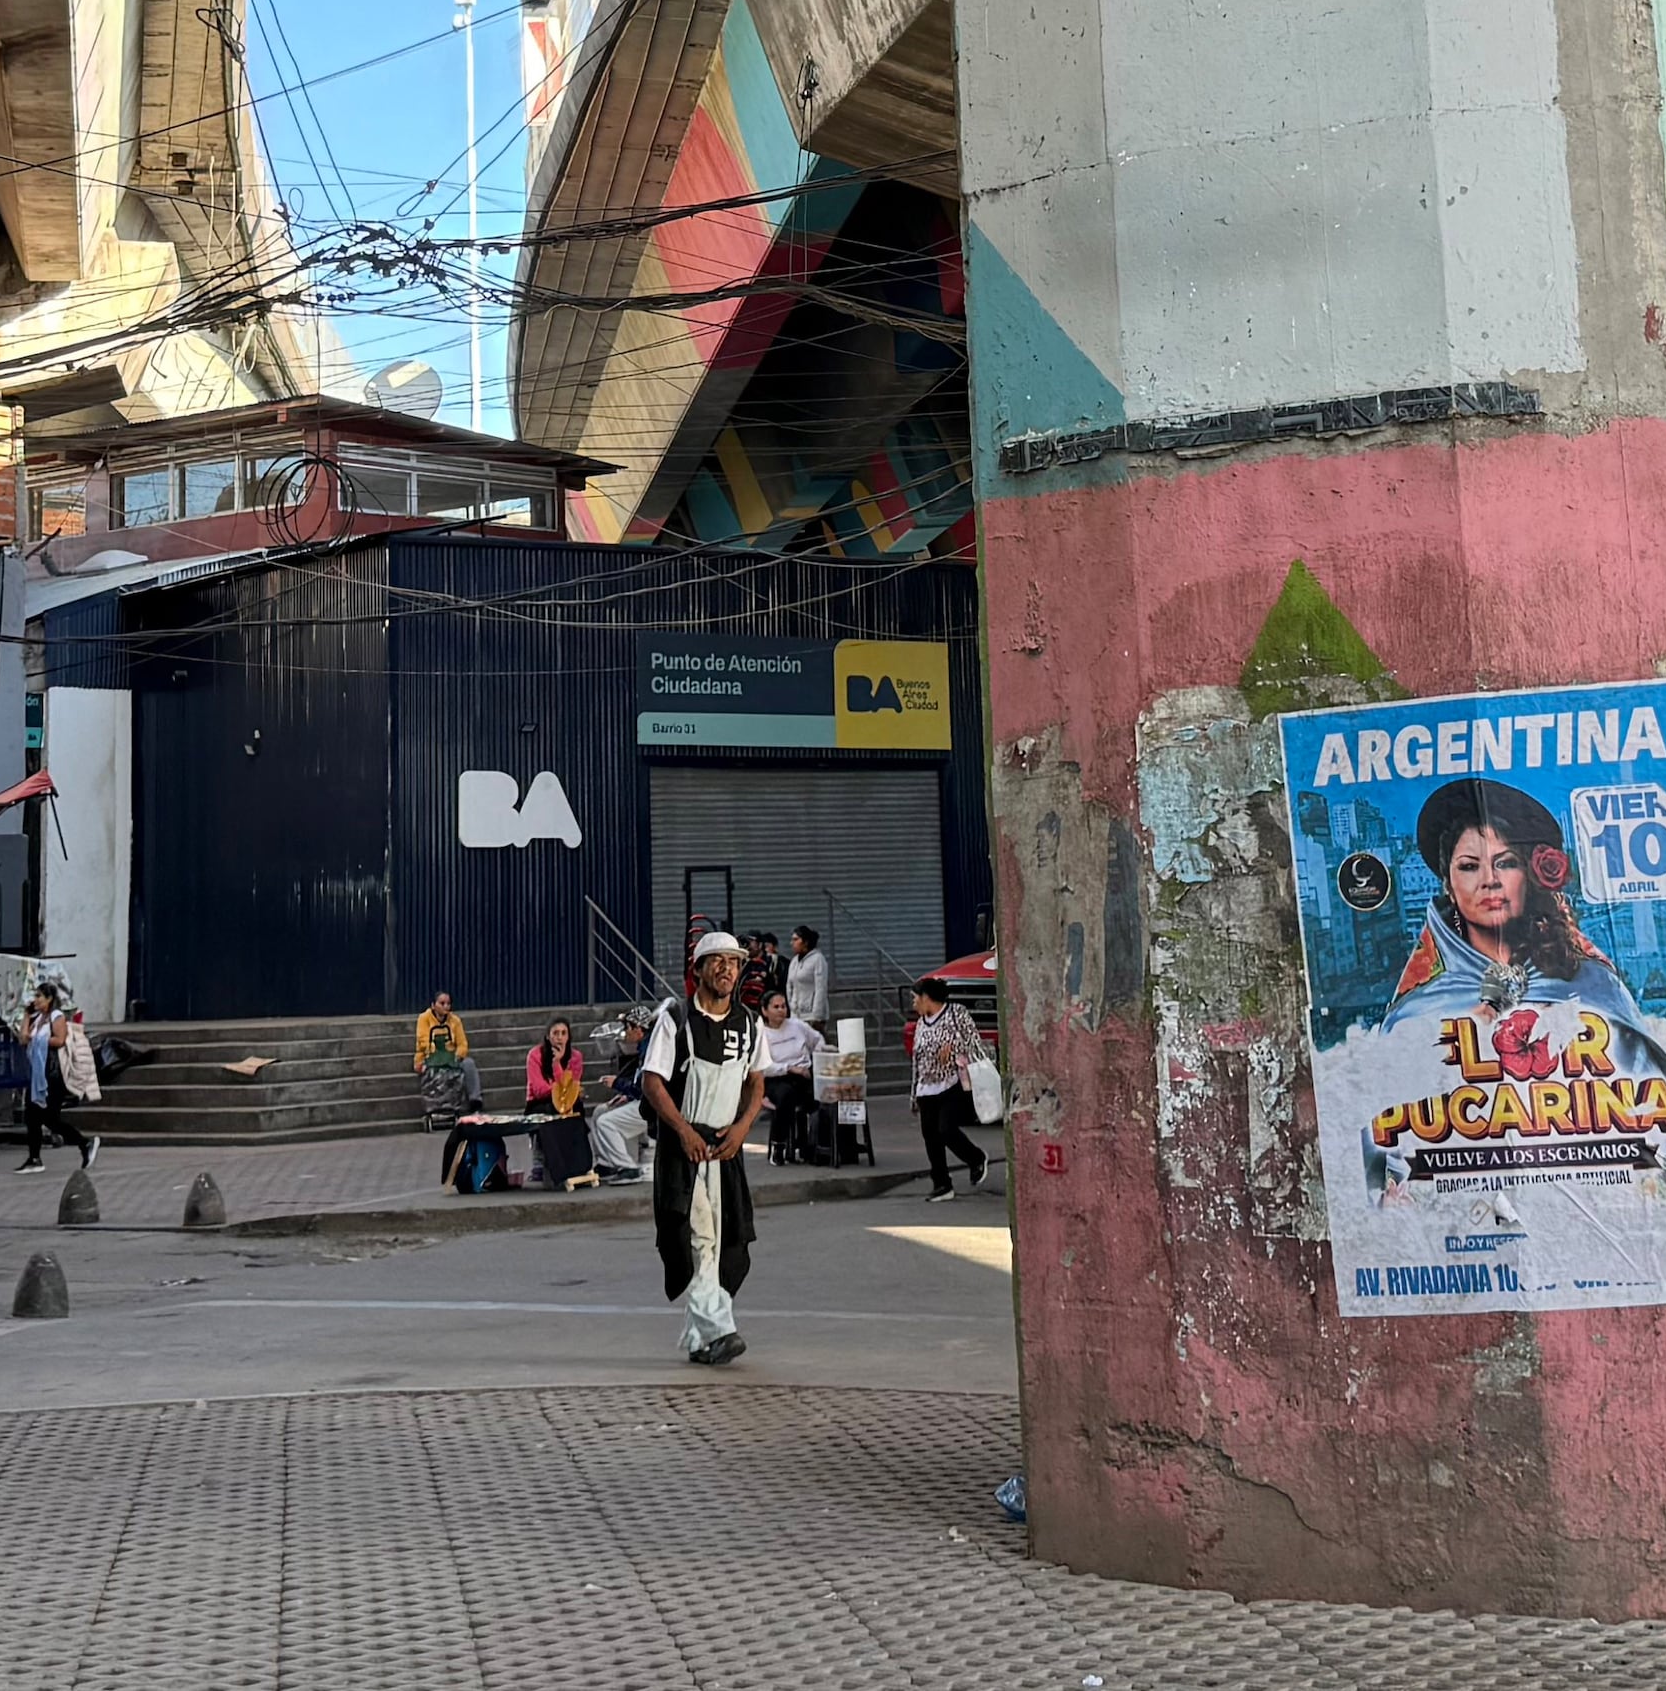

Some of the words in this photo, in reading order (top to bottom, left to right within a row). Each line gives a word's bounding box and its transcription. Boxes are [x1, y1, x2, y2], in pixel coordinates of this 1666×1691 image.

[650, 652, 702, 671] Punto
[704, 653, 726, 672] de
[728, 654, 802, 674] Atención
[650, 675, 743, 696] Ciudadana
[895, 678, 931, 690] Buenos
[846, 675, 903, 714] BA
[902, 689, 929, 700] Aires
[905, 699, 939, 711] Ciudad
[651, 722, 683, 734] Barrio
[458, 769, 583, 849] BA
[1618, 880, 1660, 895] ABRIL
[1422, 1150, 1486, 1169] VUELVE
[1489, 1149, 1501, 1165] A
[1504, 1147, 1535, 1165] LOS
[1538, 1142, 1641, 1164] ESCENARIOS
[1490, 1176, 1503, 1192] LA
[1355, 1267, 1385, 1298] AV.
[1386, 1263, 1490, 1297] RIVADAVIA
